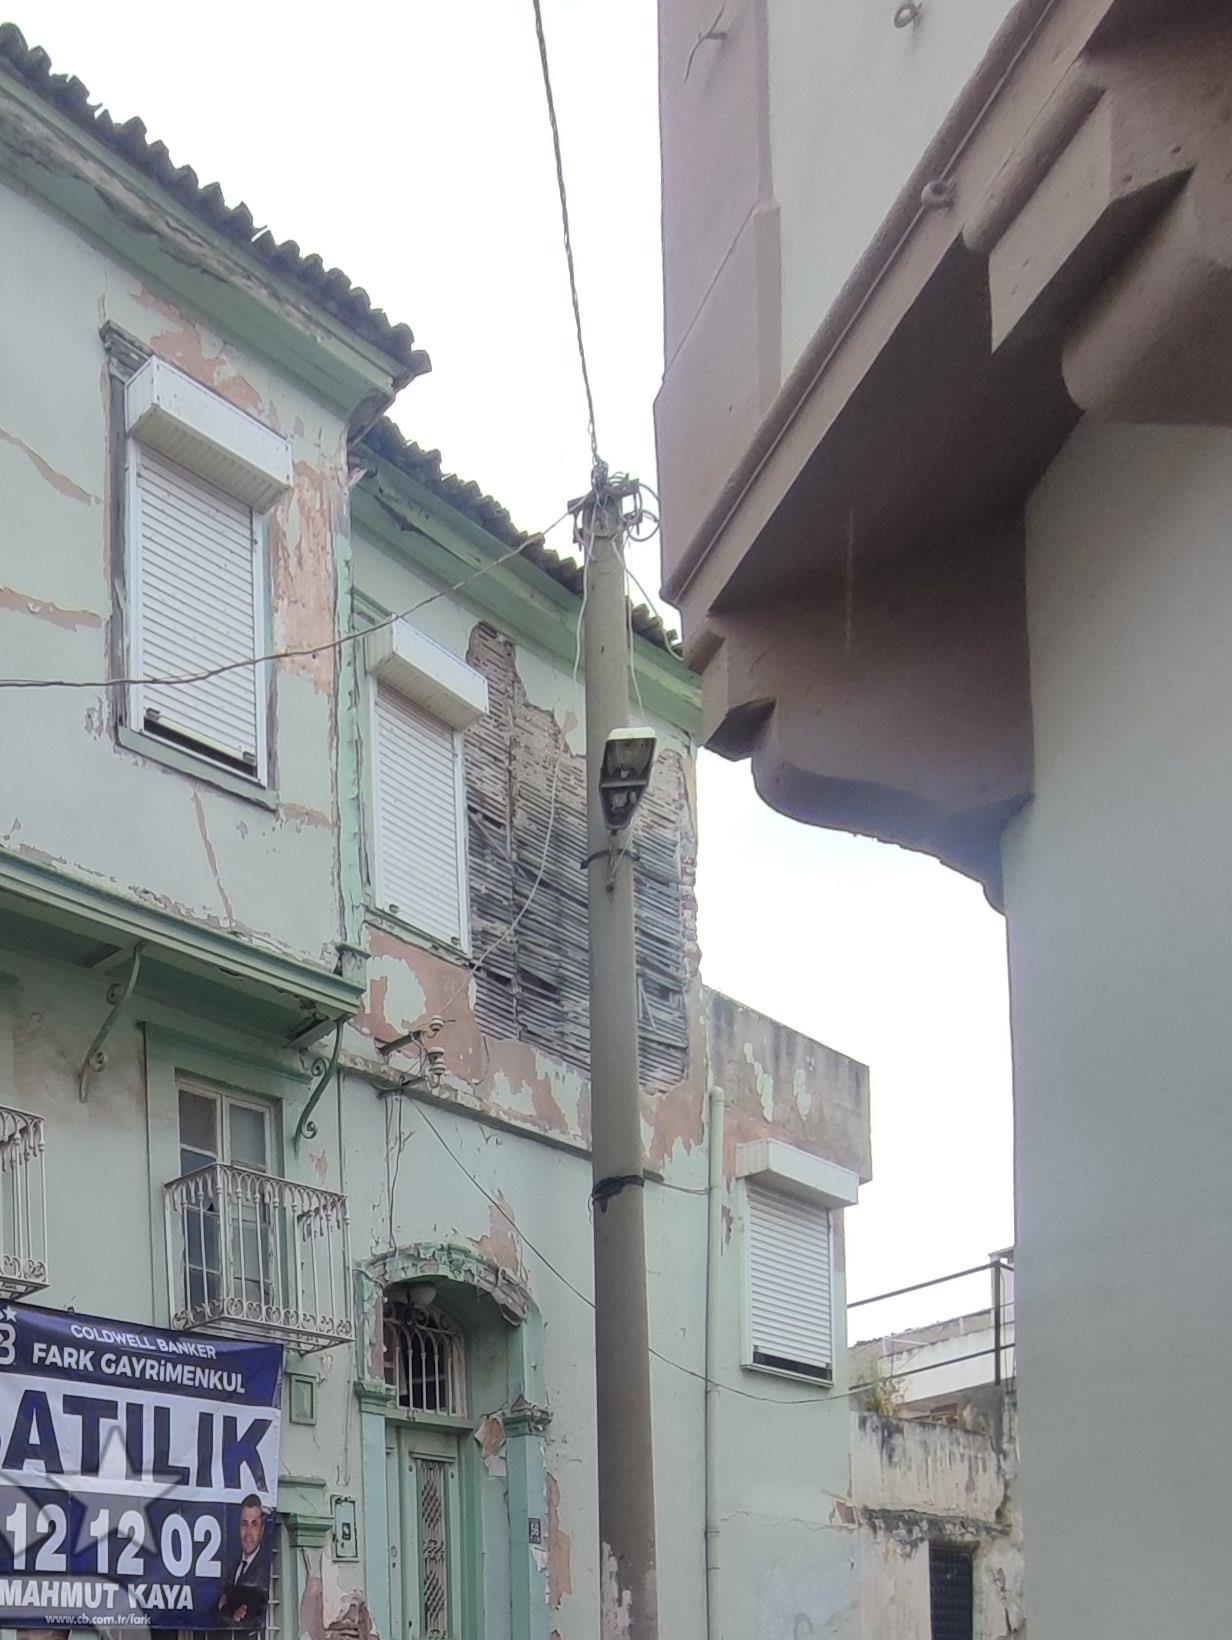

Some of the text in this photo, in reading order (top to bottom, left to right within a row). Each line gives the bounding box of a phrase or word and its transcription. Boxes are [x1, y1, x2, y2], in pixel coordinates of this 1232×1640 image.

[70, 1324, 217, 1359] COLDWELL BANKER
[32, 1342, 95, 1372] FARK
[89, 1508, 146, 1576] 12
[160, 1514, 222, 1579] 02
[127, 1583, 194, 1610] KAYA
[45, 1613, 152, 1626] www.cb.com.tr/fark
